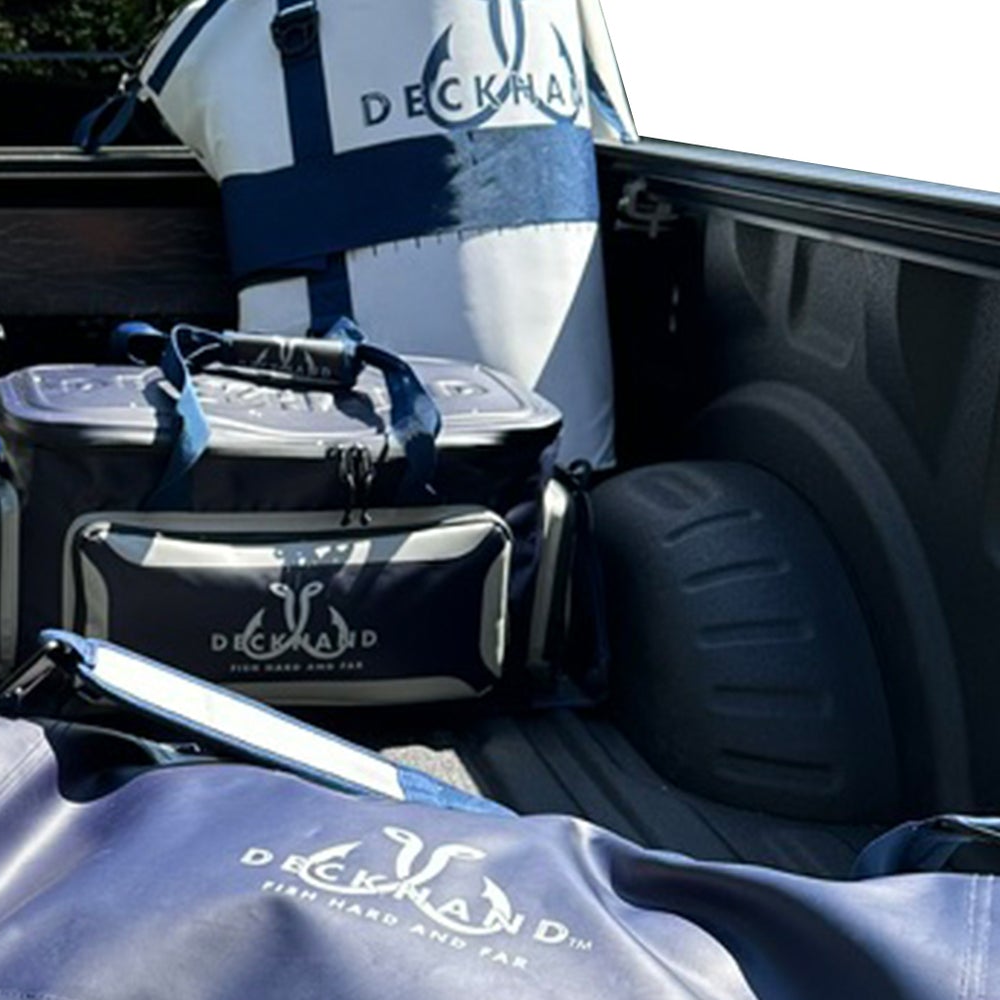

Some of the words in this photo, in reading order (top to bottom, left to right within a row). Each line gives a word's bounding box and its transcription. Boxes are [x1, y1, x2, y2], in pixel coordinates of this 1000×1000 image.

[211, 629, 378, 651] DECKHAND
[240, 847, 569, 945] DECKHAND
[261, 880, 316, 901] FISH
[329, 897, 398, 927] HARD
[409, 922, 467, 950] AND
[479, 946, 529, 969] FAR
